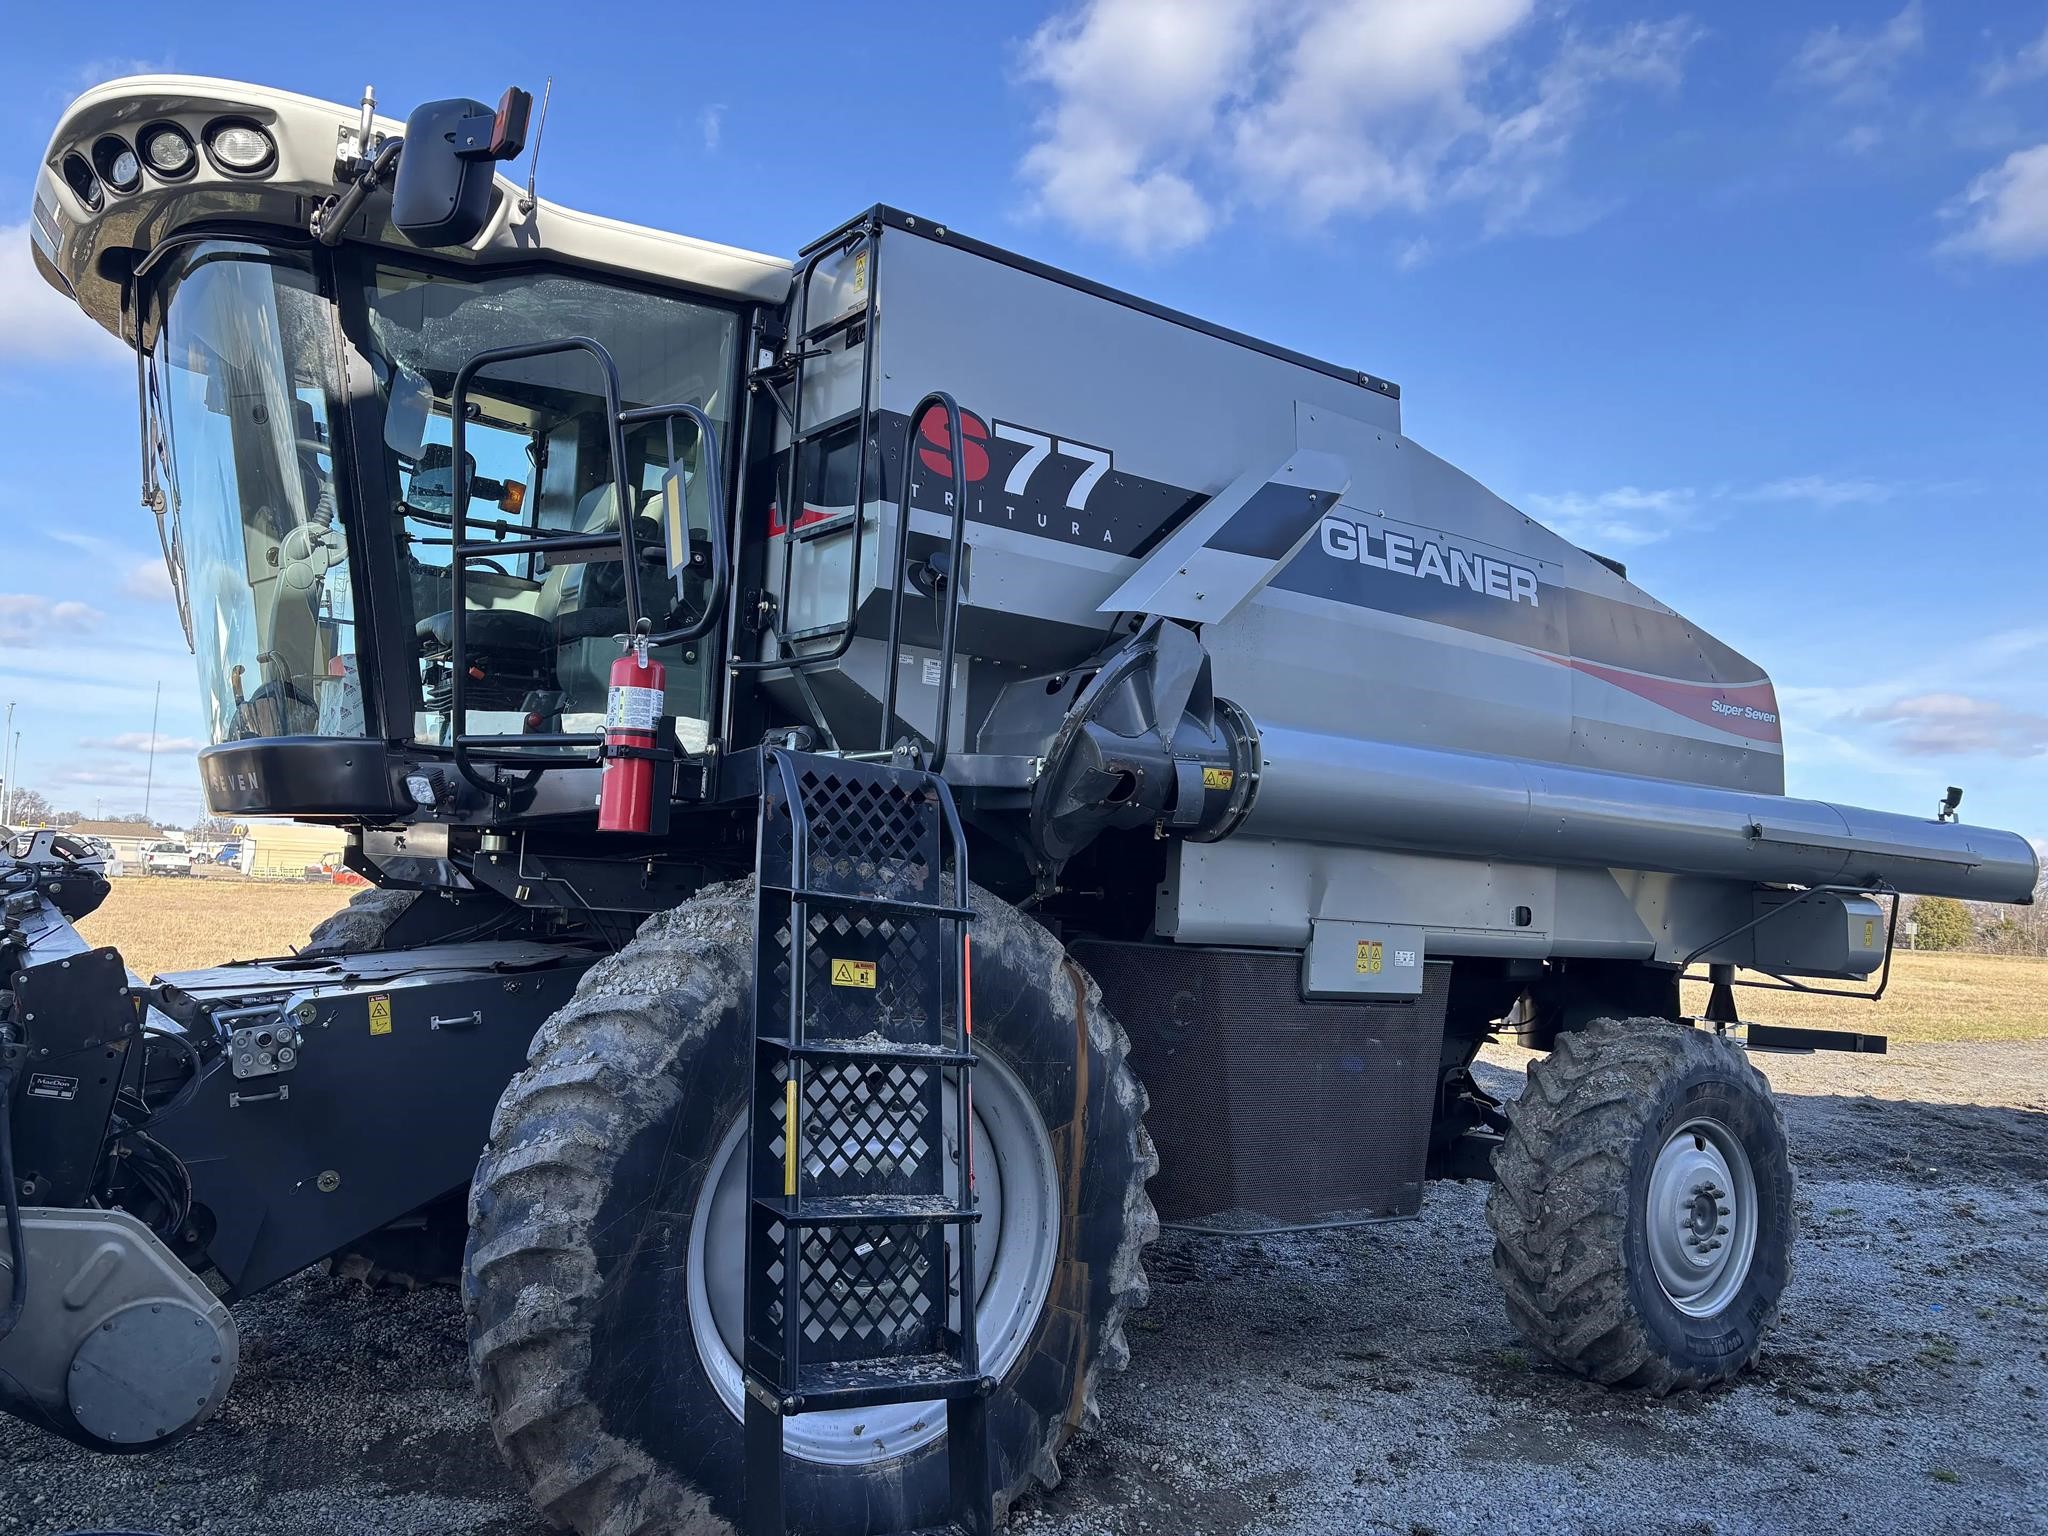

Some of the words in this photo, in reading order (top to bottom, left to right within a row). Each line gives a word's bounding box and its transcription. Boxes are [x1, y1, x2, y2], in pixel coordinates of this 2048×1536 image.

[918, 404, 1113, 511] S77
[911, 483, 1113, 543] TRITURA
[1319, 515, 1540, 608] GLEANER
[1711, 699, 1744, 716] Super
[1744, 706, 1777, 723] Seven
[37, 1078, 70, 1087] MacDon
